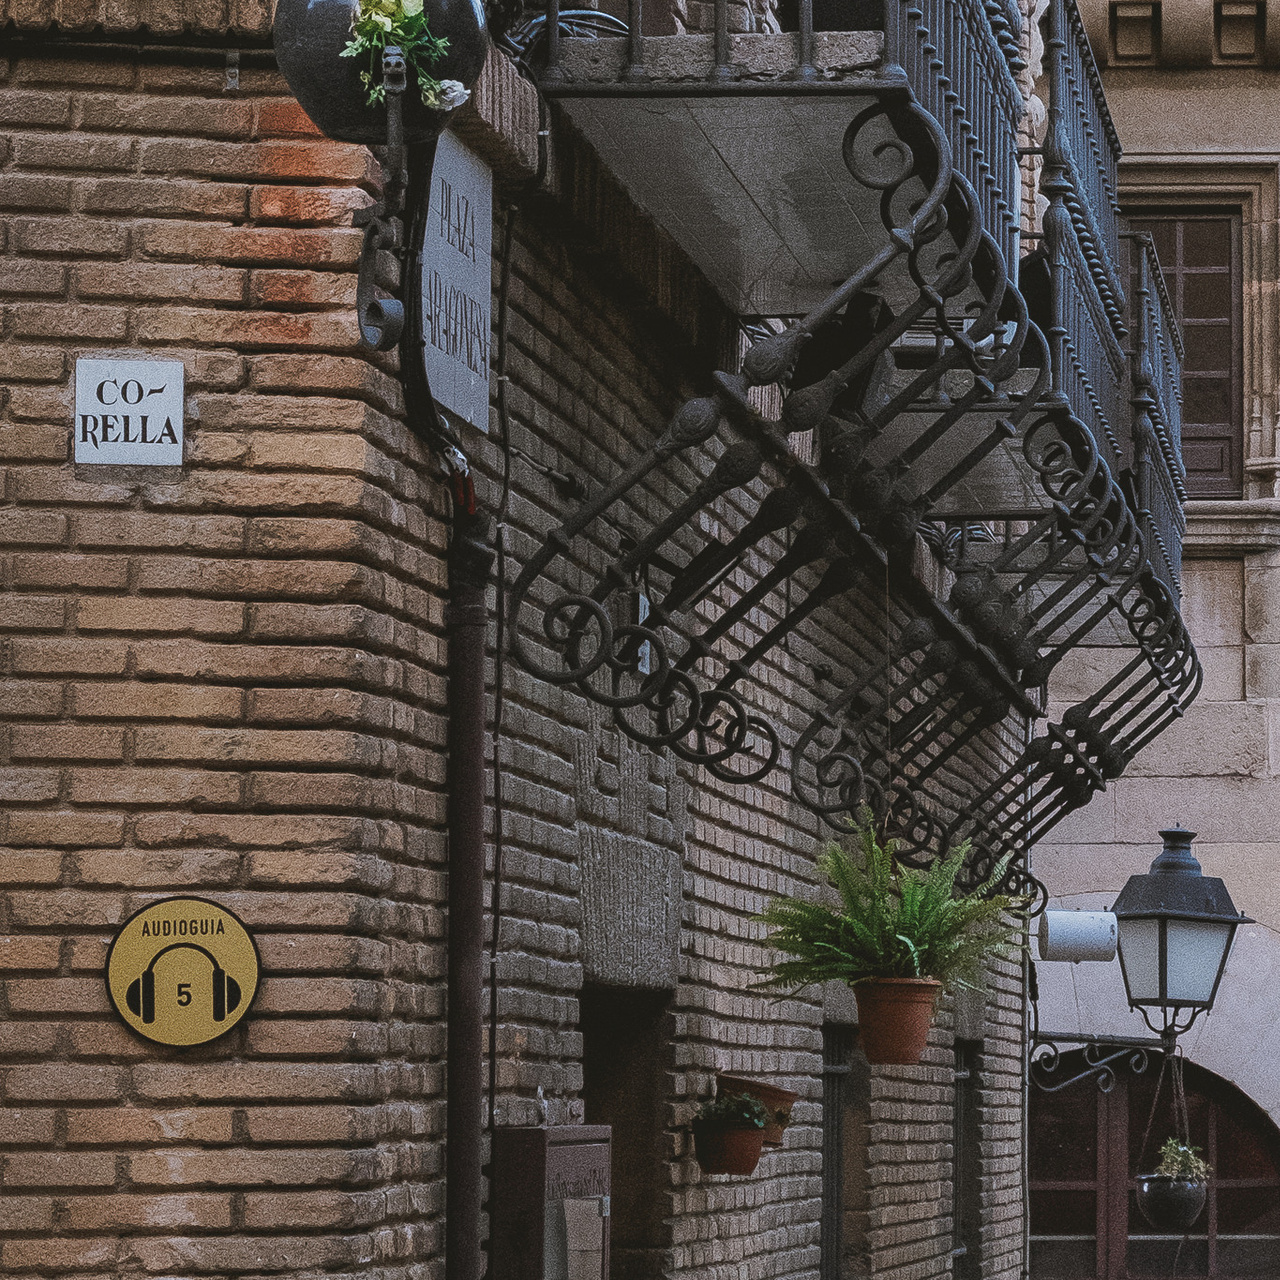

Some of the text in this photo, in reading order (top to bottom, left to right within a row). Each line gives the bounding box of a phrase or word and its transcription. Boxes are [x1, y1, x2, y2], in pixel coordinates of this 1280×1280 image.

[439, 176, 476, 263] PLAZA
[426, 270, 488, 381] ARAGONESA
[79, 413, 179, 450] RELLA
[141, 919, 225, 937] AUDIOGUIA
[176, 983, 192, 1007] 5
